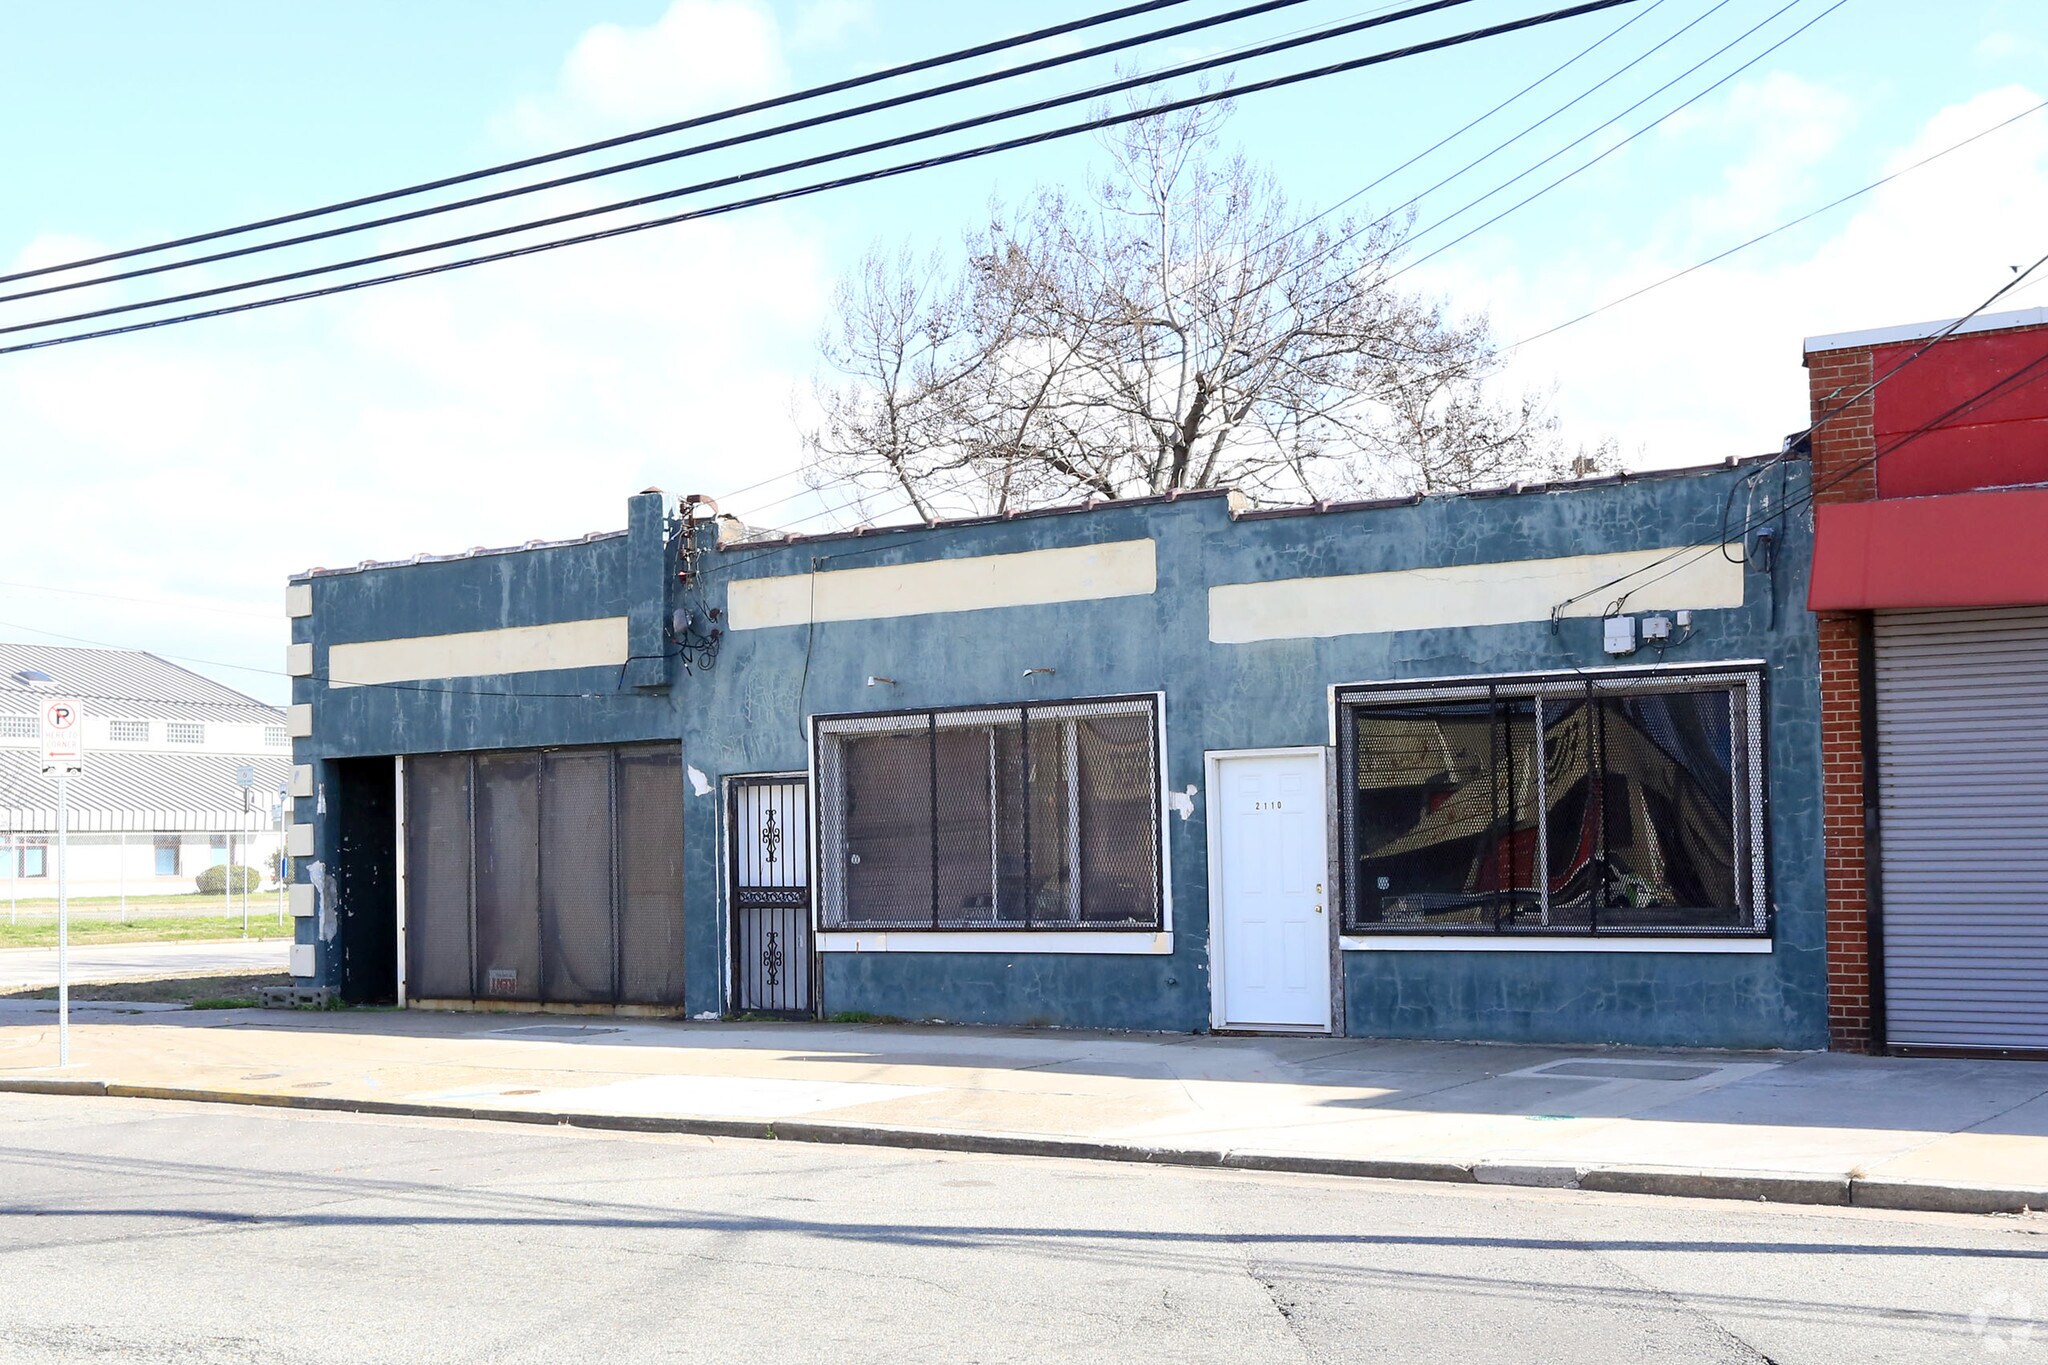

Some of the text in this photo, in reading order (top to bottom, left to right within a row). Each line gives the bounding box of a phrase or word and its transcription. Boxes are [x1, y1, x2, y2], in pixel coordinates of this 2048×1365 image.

[56, 708, 70, 725] P
[46, 740, 77, 749] CORNER
[1255, 801, 1282, 810] 2110
